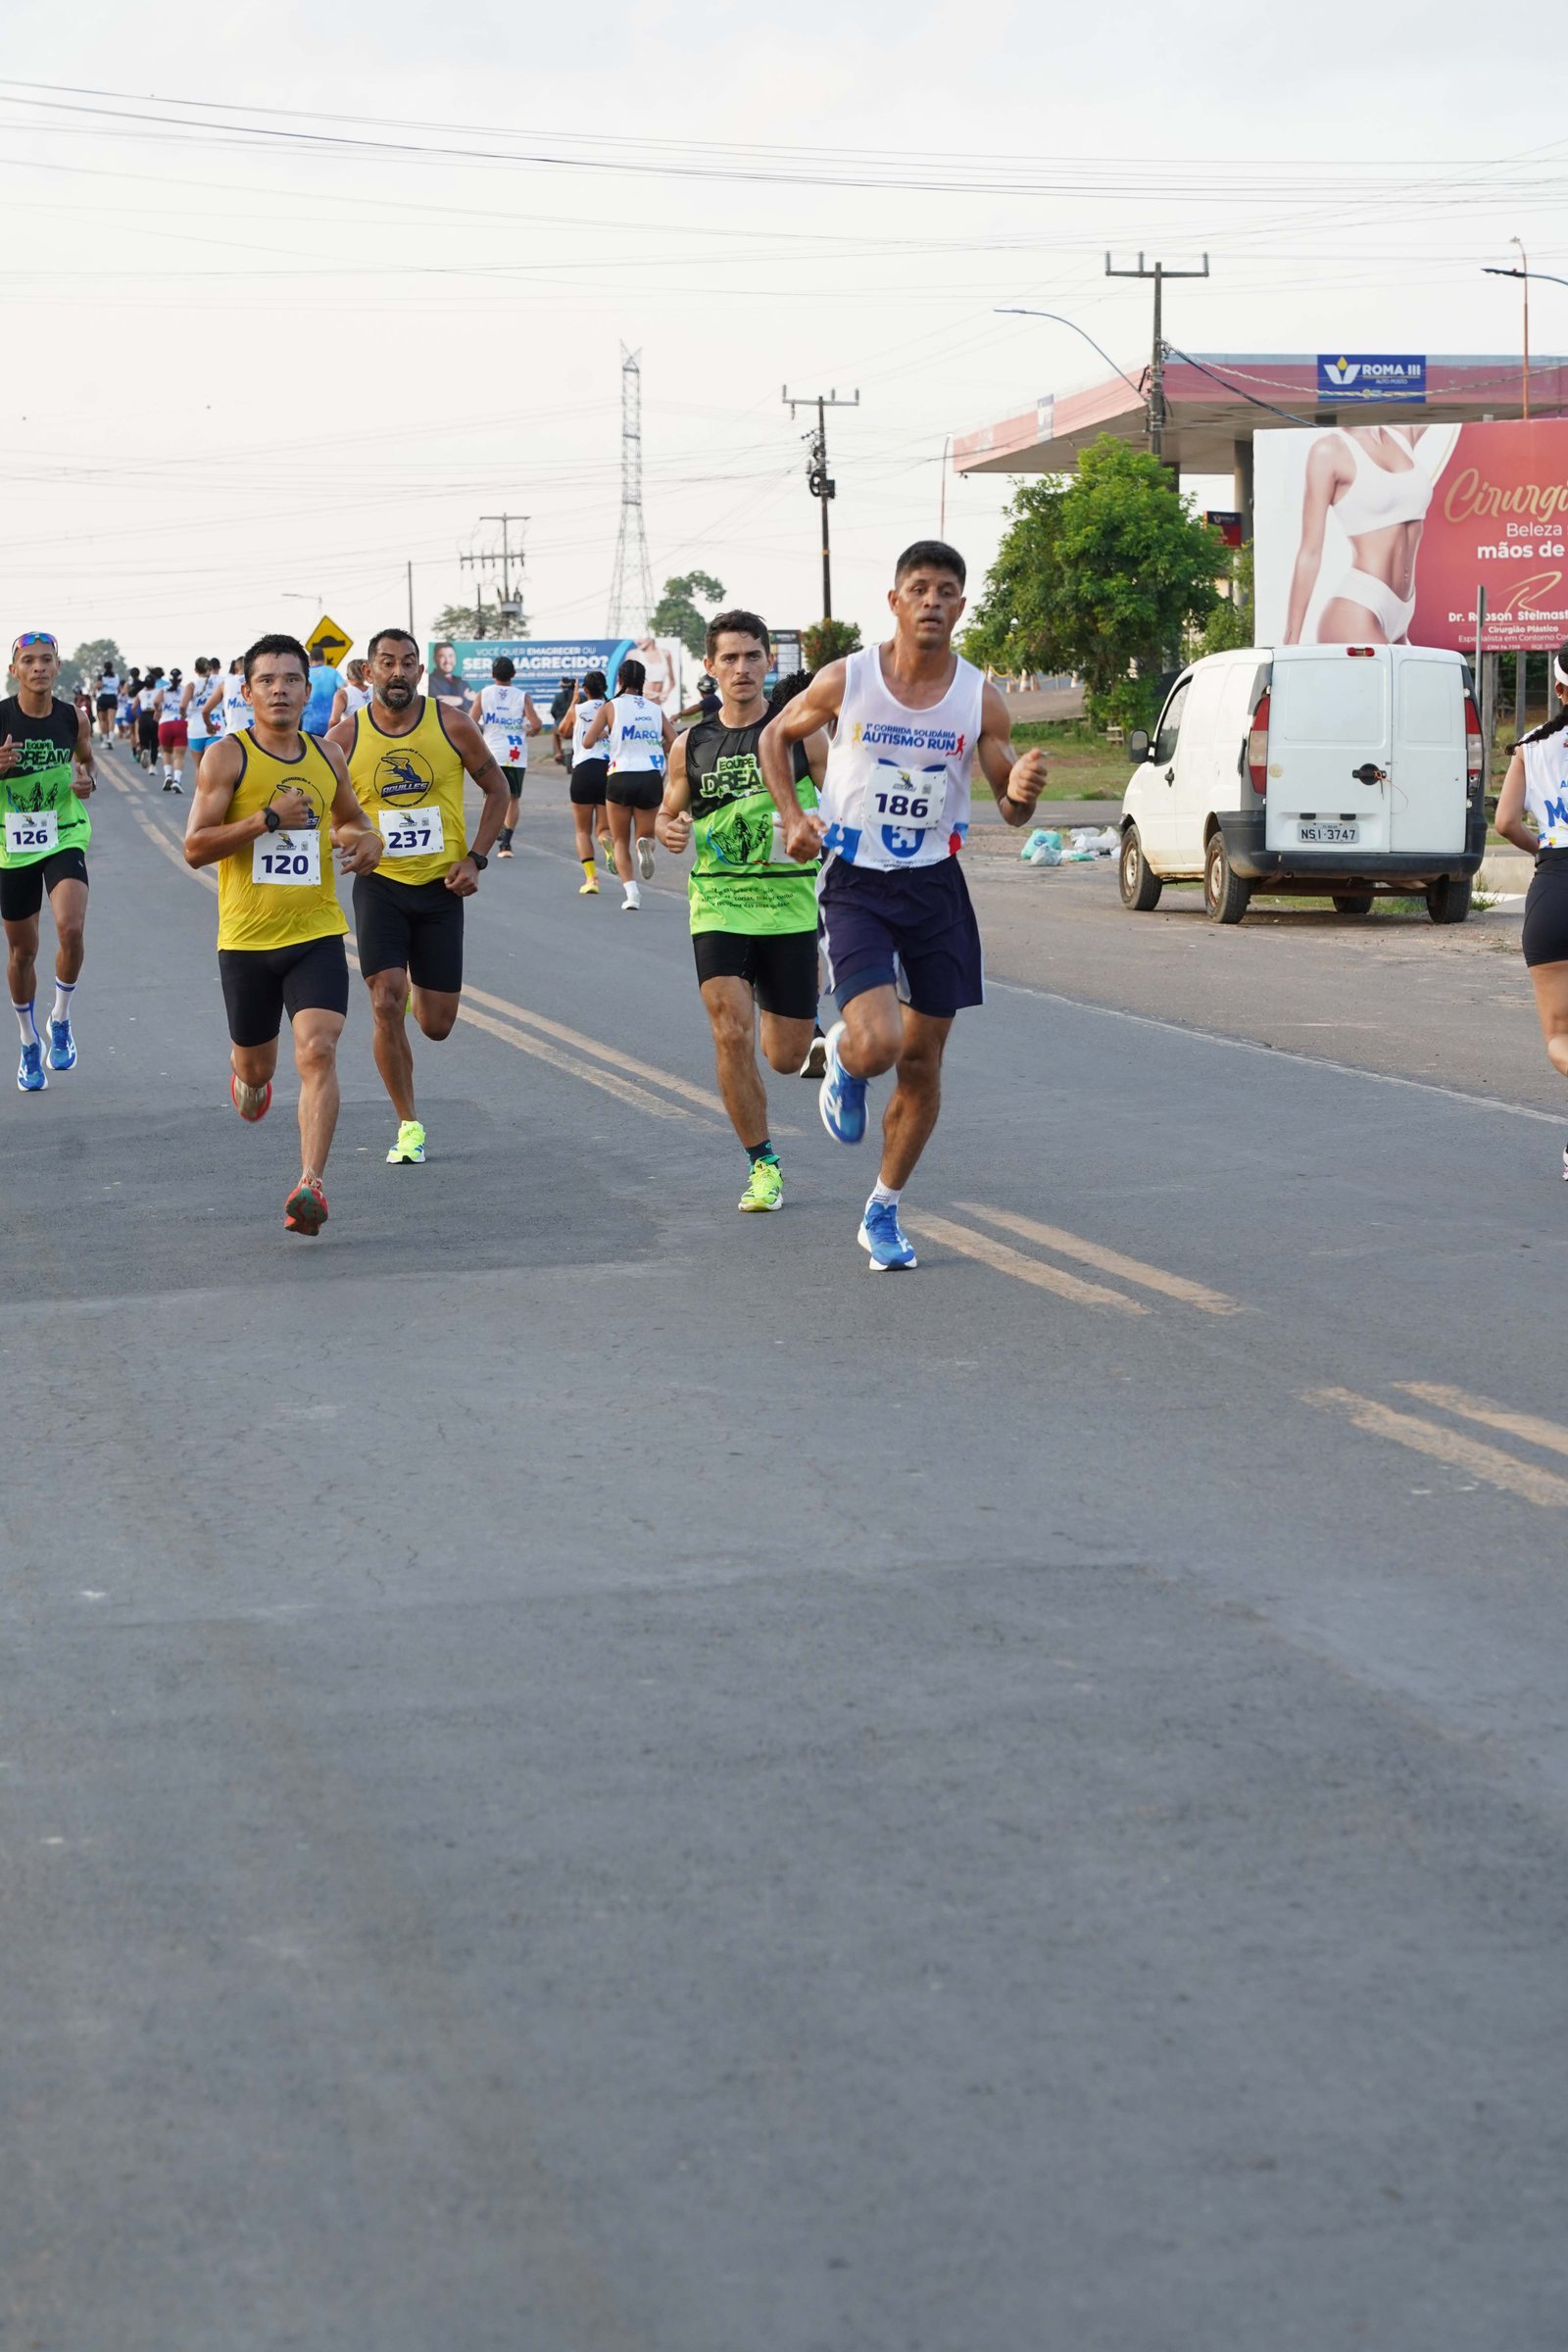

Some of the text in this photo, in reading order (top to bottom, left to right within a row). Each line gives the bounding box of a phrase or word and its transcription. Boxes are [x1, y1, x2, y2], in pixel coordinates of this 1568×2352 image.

[1361, 364, 1421, 376] ROMA III
[1506, 521, 1562, 537] Beleza
[1477, 540, 1565, 560] mãos de
[1448, 612, 1465, 622] Dr.
[1489, 624, 1559, 635] Cirurgião Plástico
[501, 646, 526, 656] QUER
[582, 646, 596, 655] OU
[463, 657, 493, 670] SER
[874, 723, 911, 735] CORRIDA
[913, 728, 956, 739] SOLIDÁRIA
[862, 731, 956, 751] AUTISMO RUN
[718, 756, 756, 771] EQUIPE
[874, 793, 929, 818] 186
[13, 830, 48, 845] 126
[388, 829, 431, 849] 237
[261, 855, 309, 875] 120
